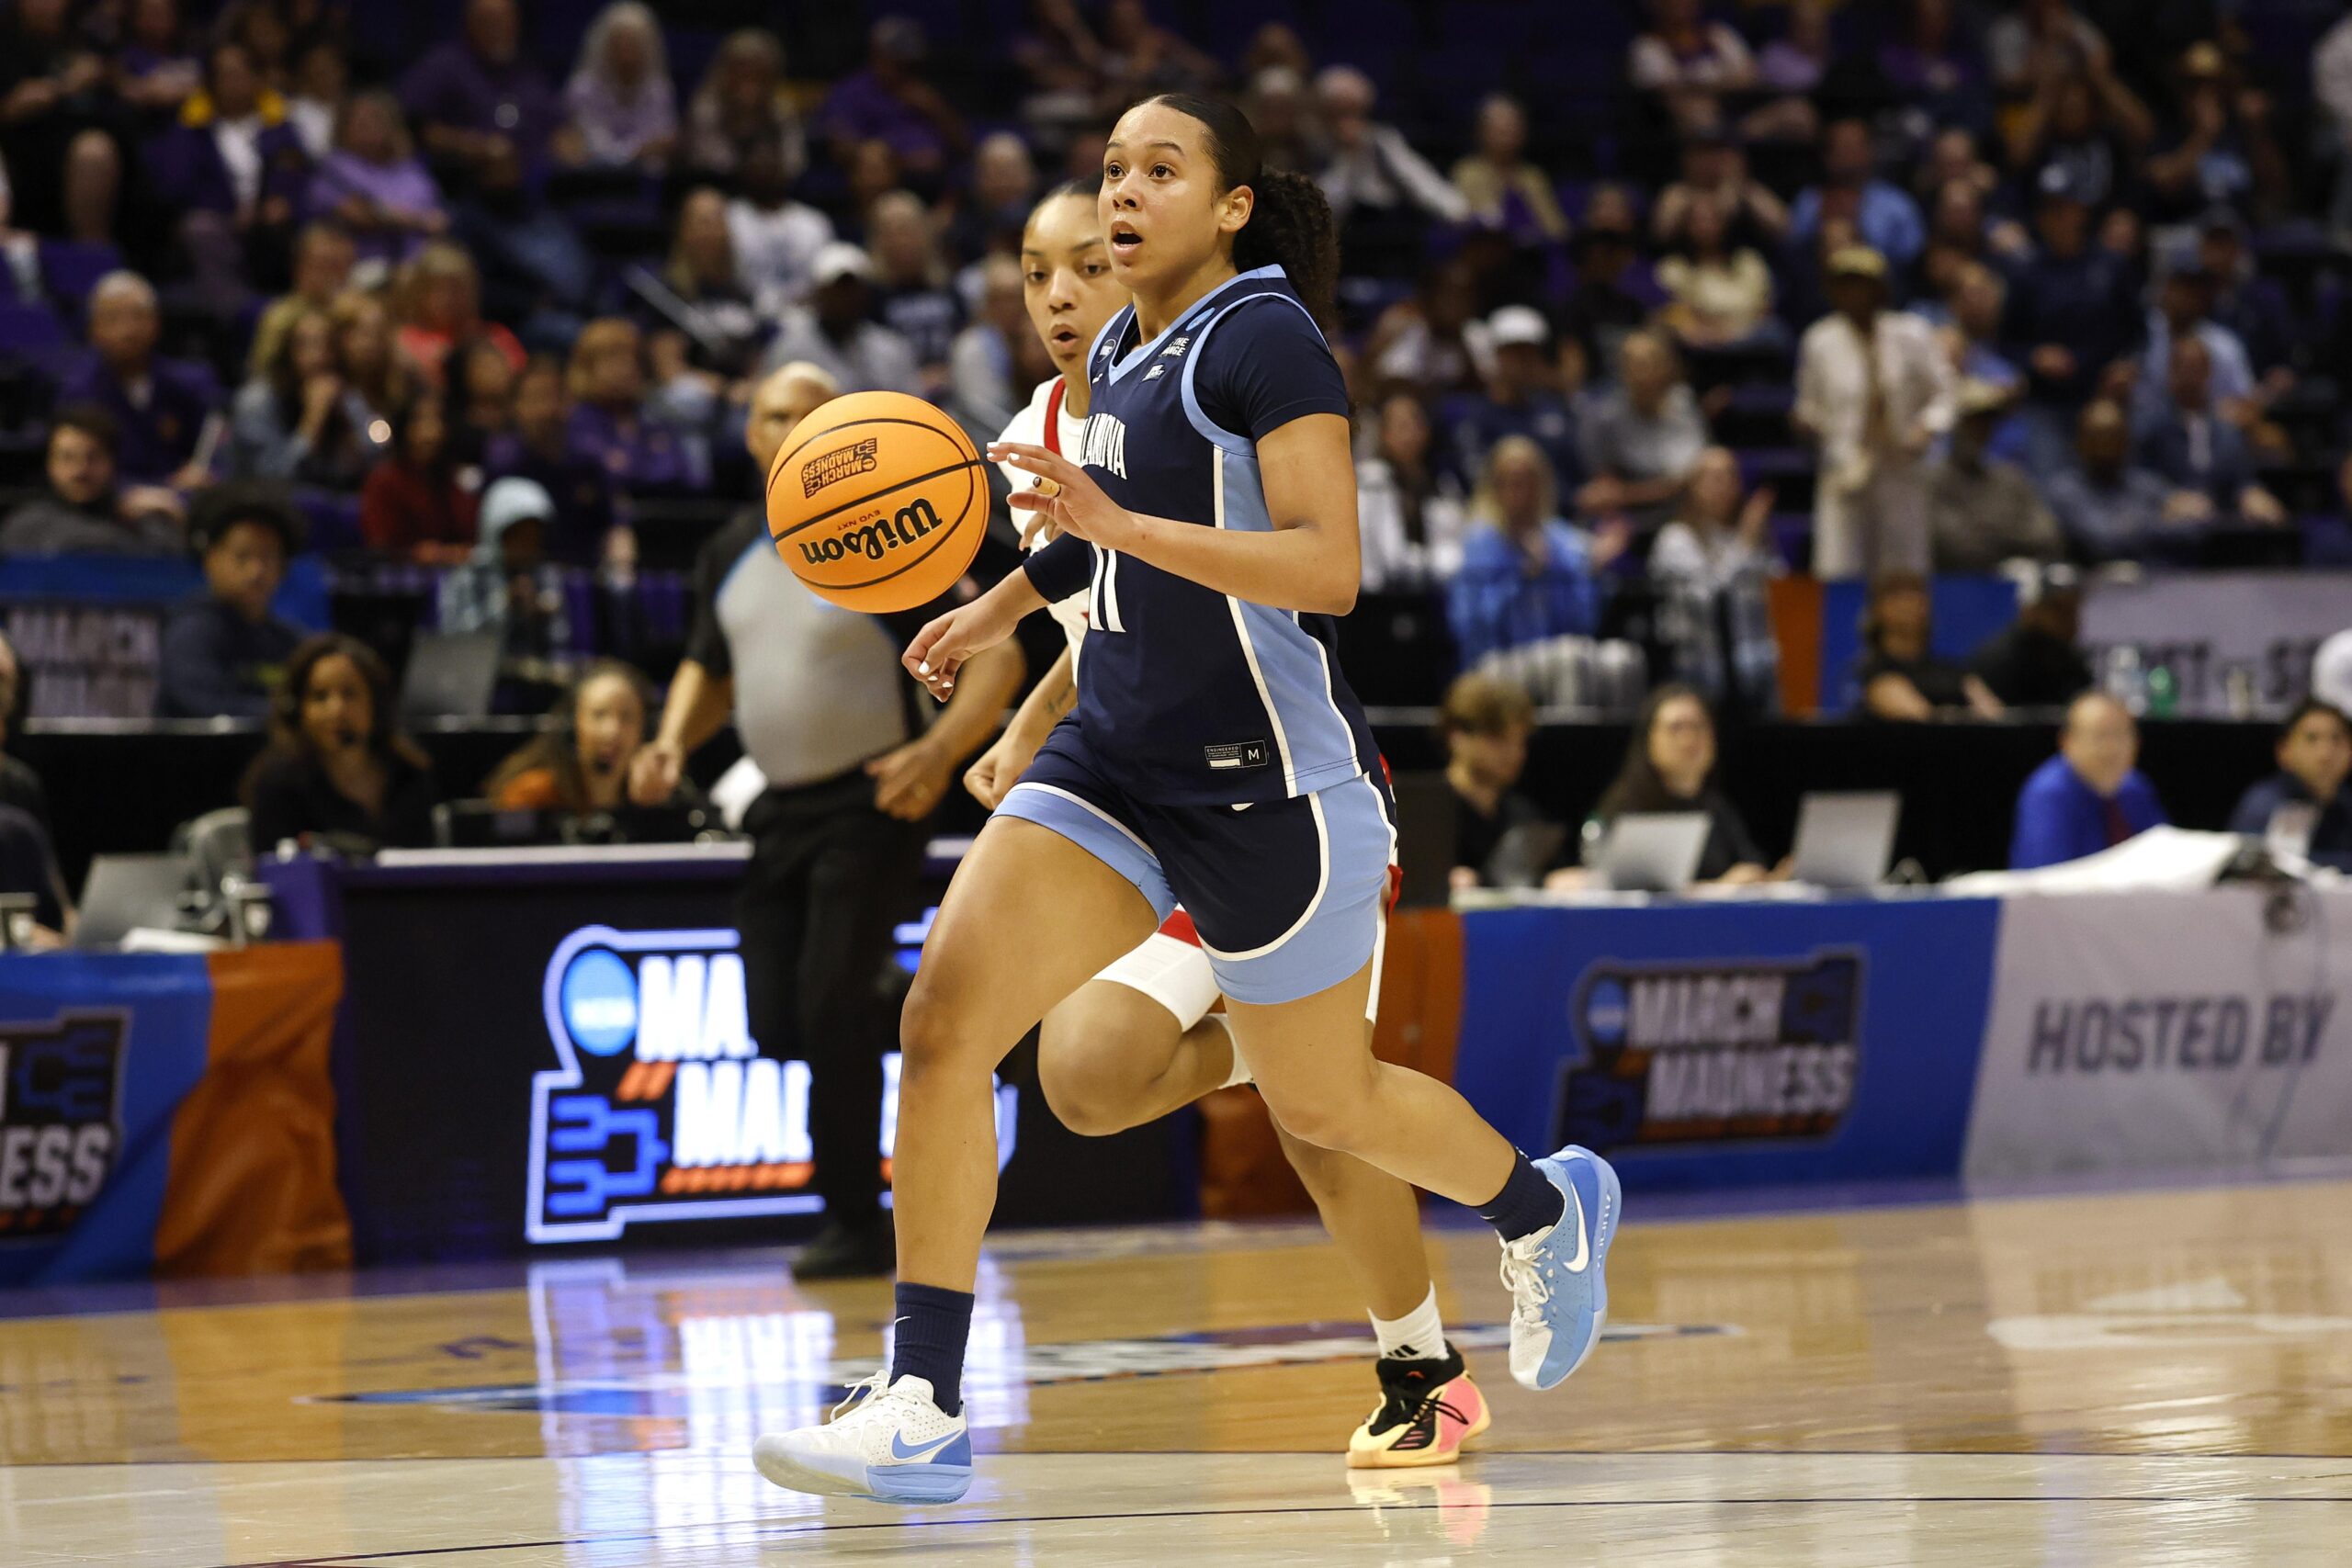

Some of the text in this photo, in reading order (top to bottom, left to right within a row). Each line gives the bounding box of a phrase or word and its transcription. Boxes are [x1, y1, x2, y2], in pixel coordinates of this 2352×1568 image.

[801, 448, 855, 483] MADNESS
[821, 459, 863, 486] MARCH
[798, 498, 943, 564] Wilson
[837, 509, 881, 531] EVO NXT
[1248, 748, 1260, 761] M
[2026, 988, 2337, 1074] HOSTED BY
